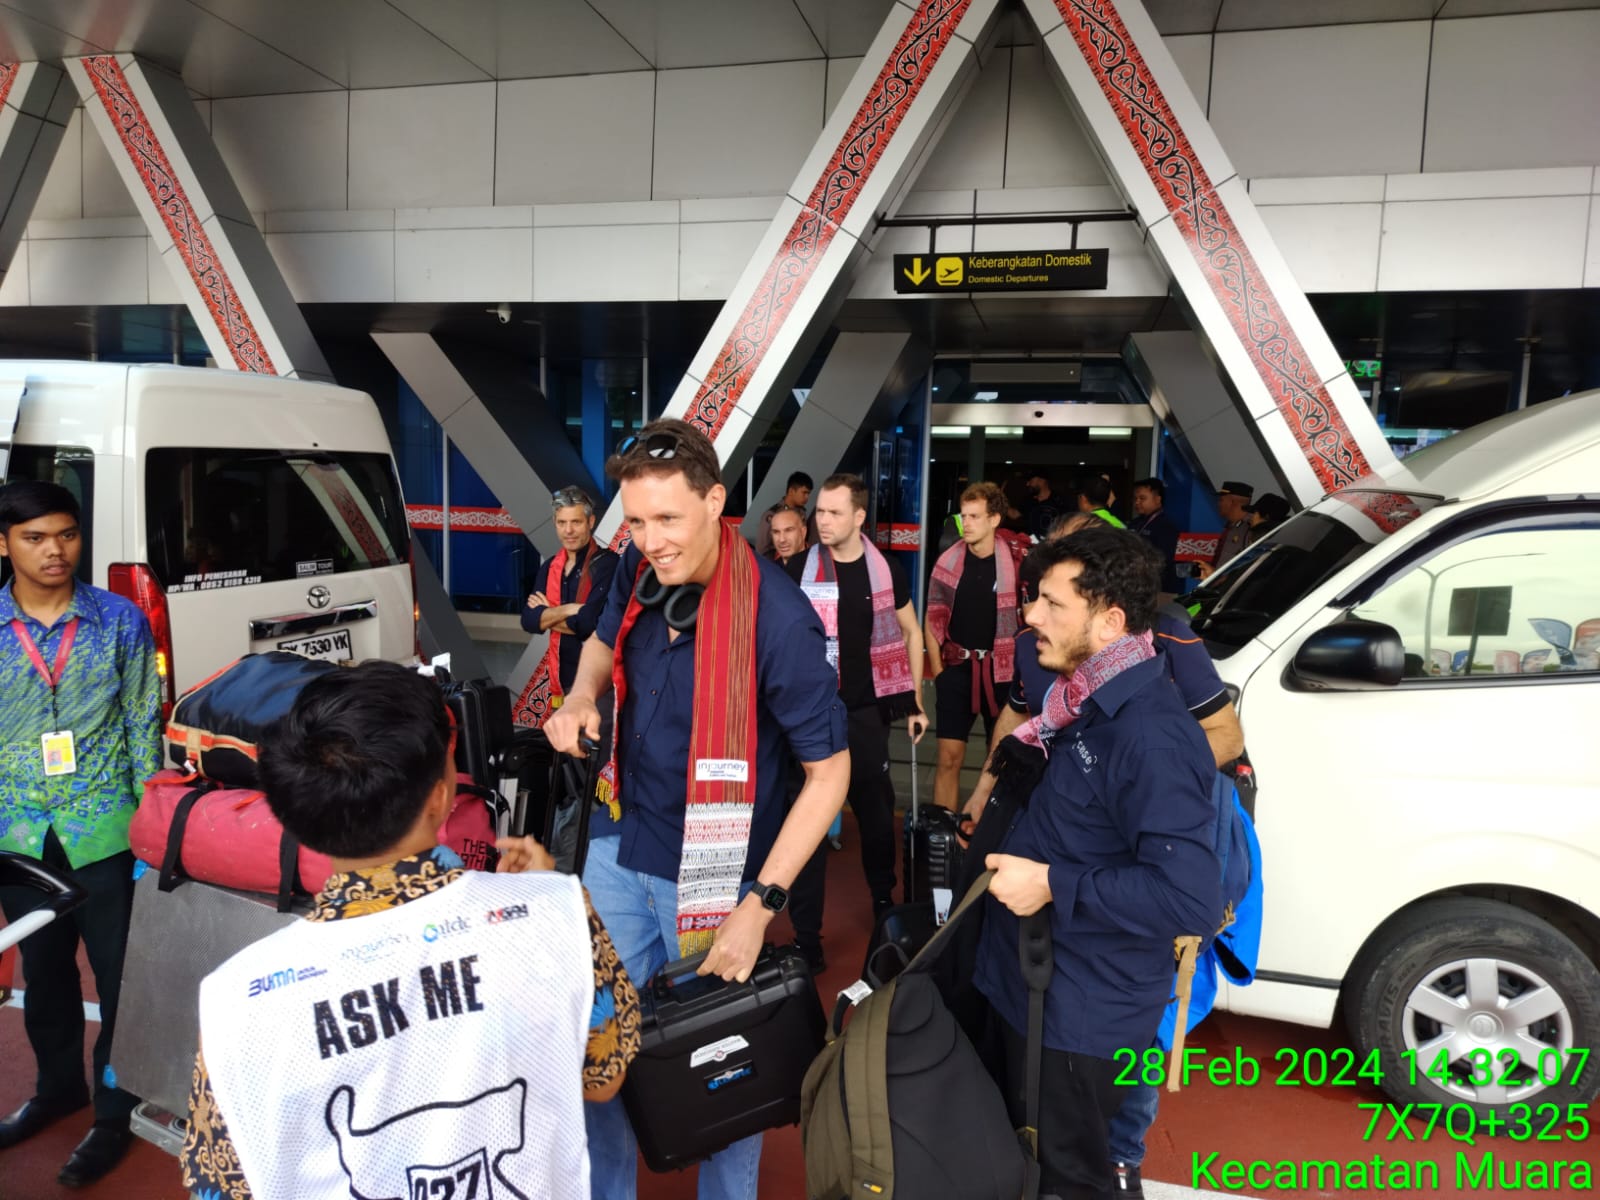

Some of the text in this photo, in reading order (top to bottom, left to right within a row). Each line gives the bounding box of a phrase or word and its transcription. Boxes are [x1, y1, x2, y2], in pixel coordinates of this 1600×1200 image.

[968, 253, 1092, 271] Keberangkatan Domestik
[968, 274, 1049, 284] Domestic Departures
[184, 573, 203, 583] INFO
[302, 638, 332, 655] 7530
[332, 634, 349, 650] YK
[698, 762, 746, 773] injourney
[463, 838, 486, 855] THE
[460, 853, 486, 869] RTH
[313, 954, 484, 1060] ASK ME
